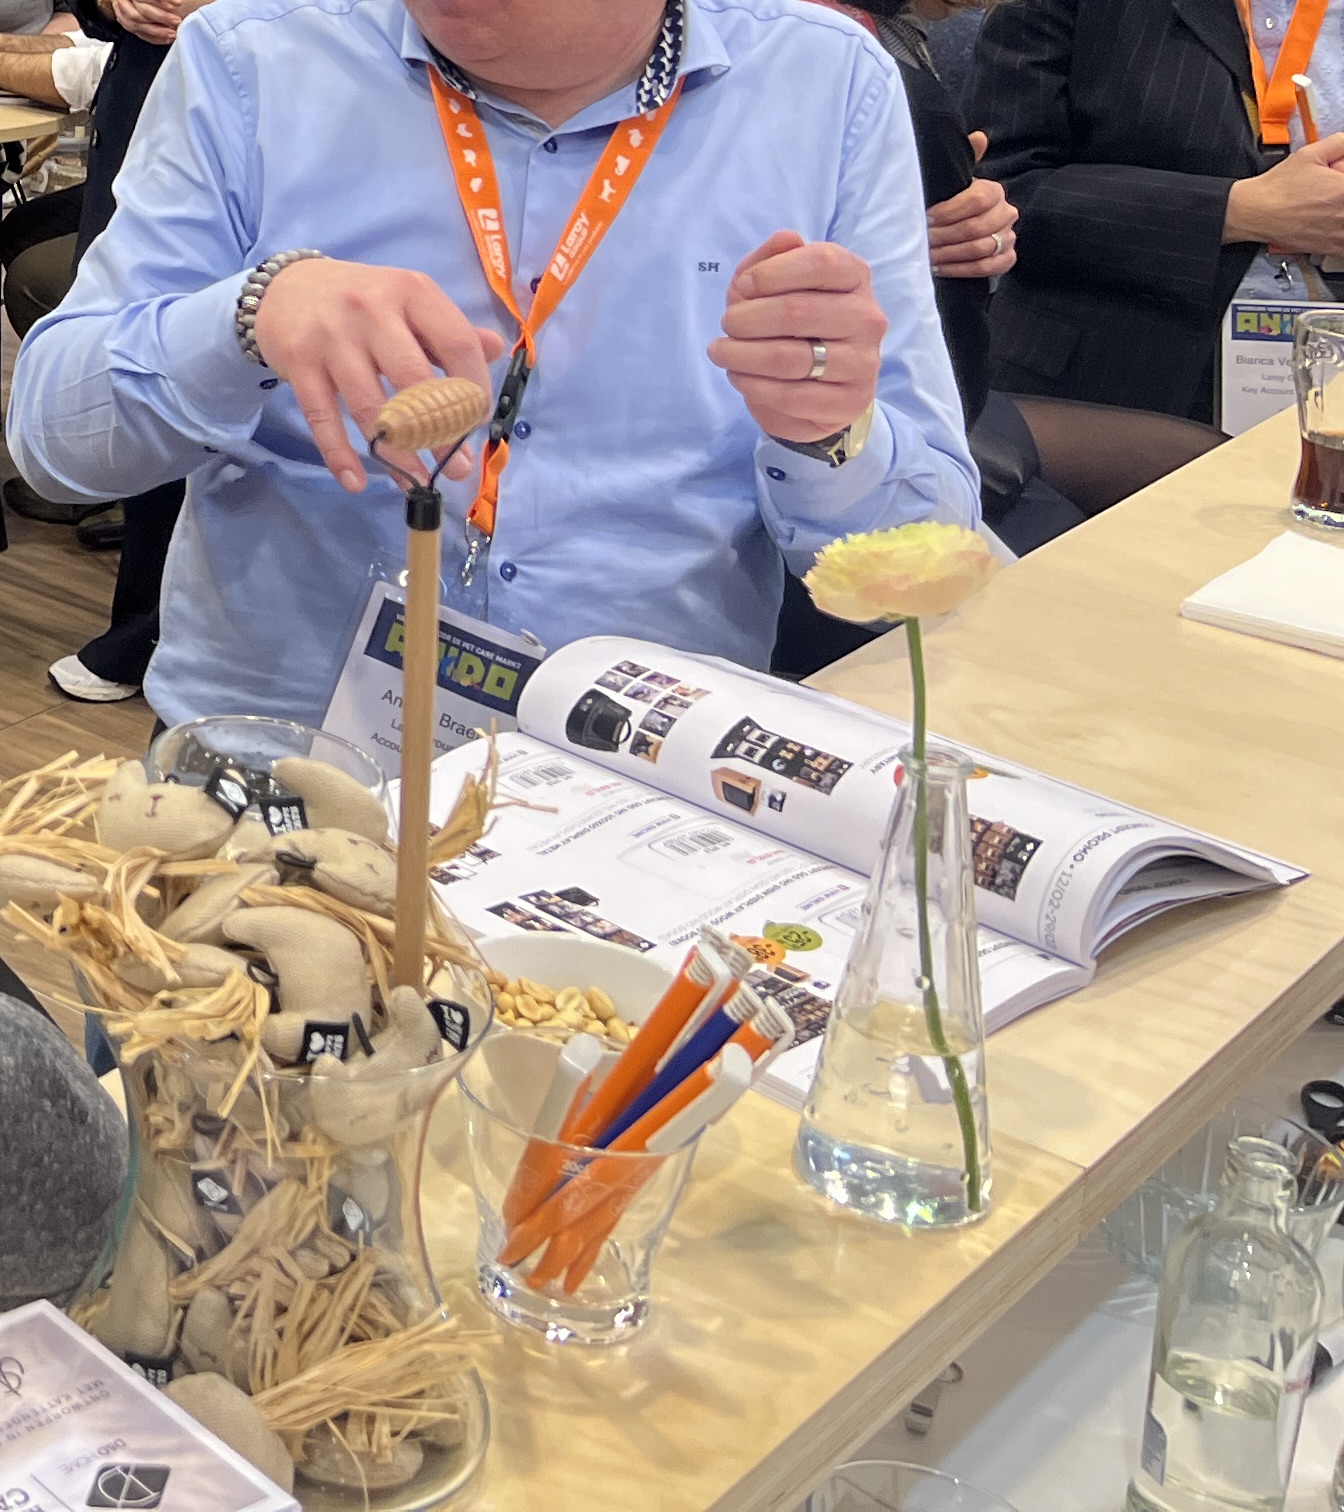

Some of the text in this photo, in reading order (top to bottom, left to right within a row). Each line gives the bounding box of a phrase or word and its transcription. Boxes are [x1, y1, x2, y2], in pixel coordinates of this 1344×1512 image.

[561, 212, 591, 255] Laroy
[698, 262, 720, 273] SH
[1236, 355, 1274, 366] Bianca
[1073, 831, 1112, 863] PROMO
